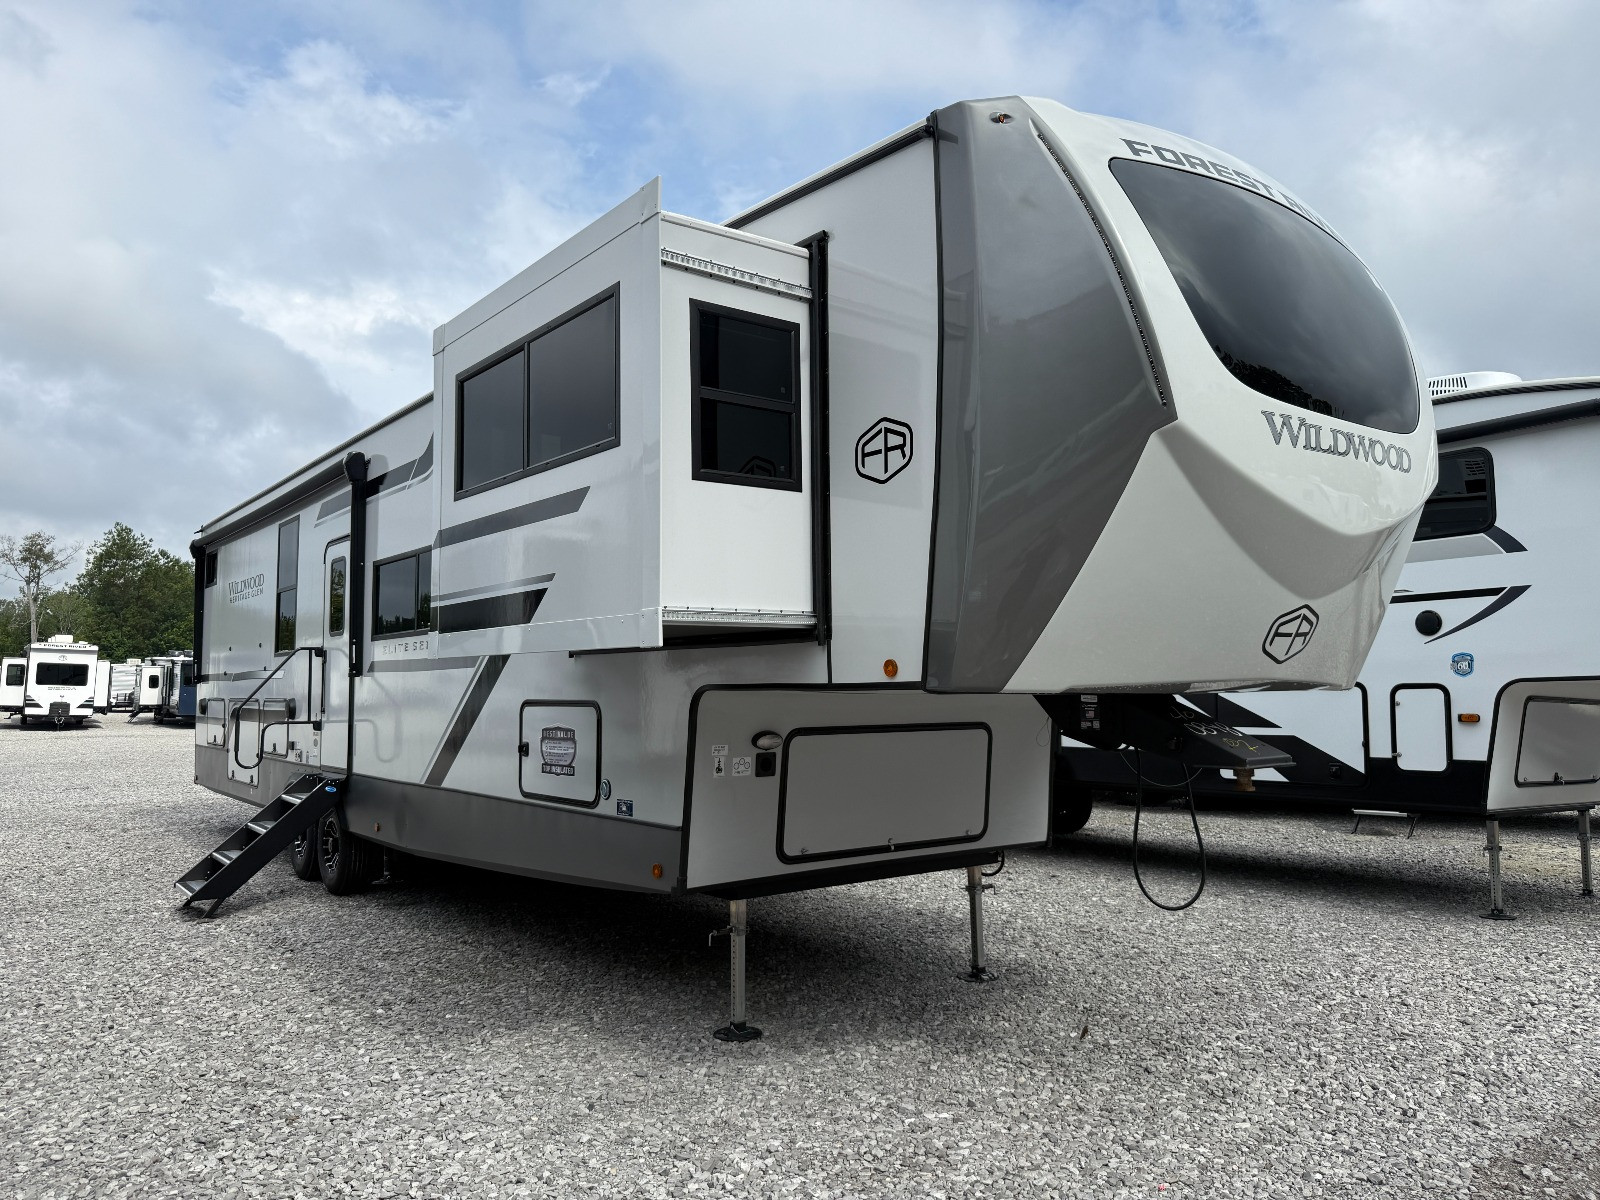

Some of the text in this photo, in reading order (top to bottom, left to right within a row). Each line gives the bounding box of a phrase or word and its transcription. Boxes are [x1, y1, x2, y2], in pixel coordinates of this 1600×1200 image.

[1119, 137, 1275, 198] FOREST
[1260, 409, 1412, 474] WILDWOOD
[228, 573, 265, 596] WILDWOOD
[382, 642, 409, 655] ELITE
